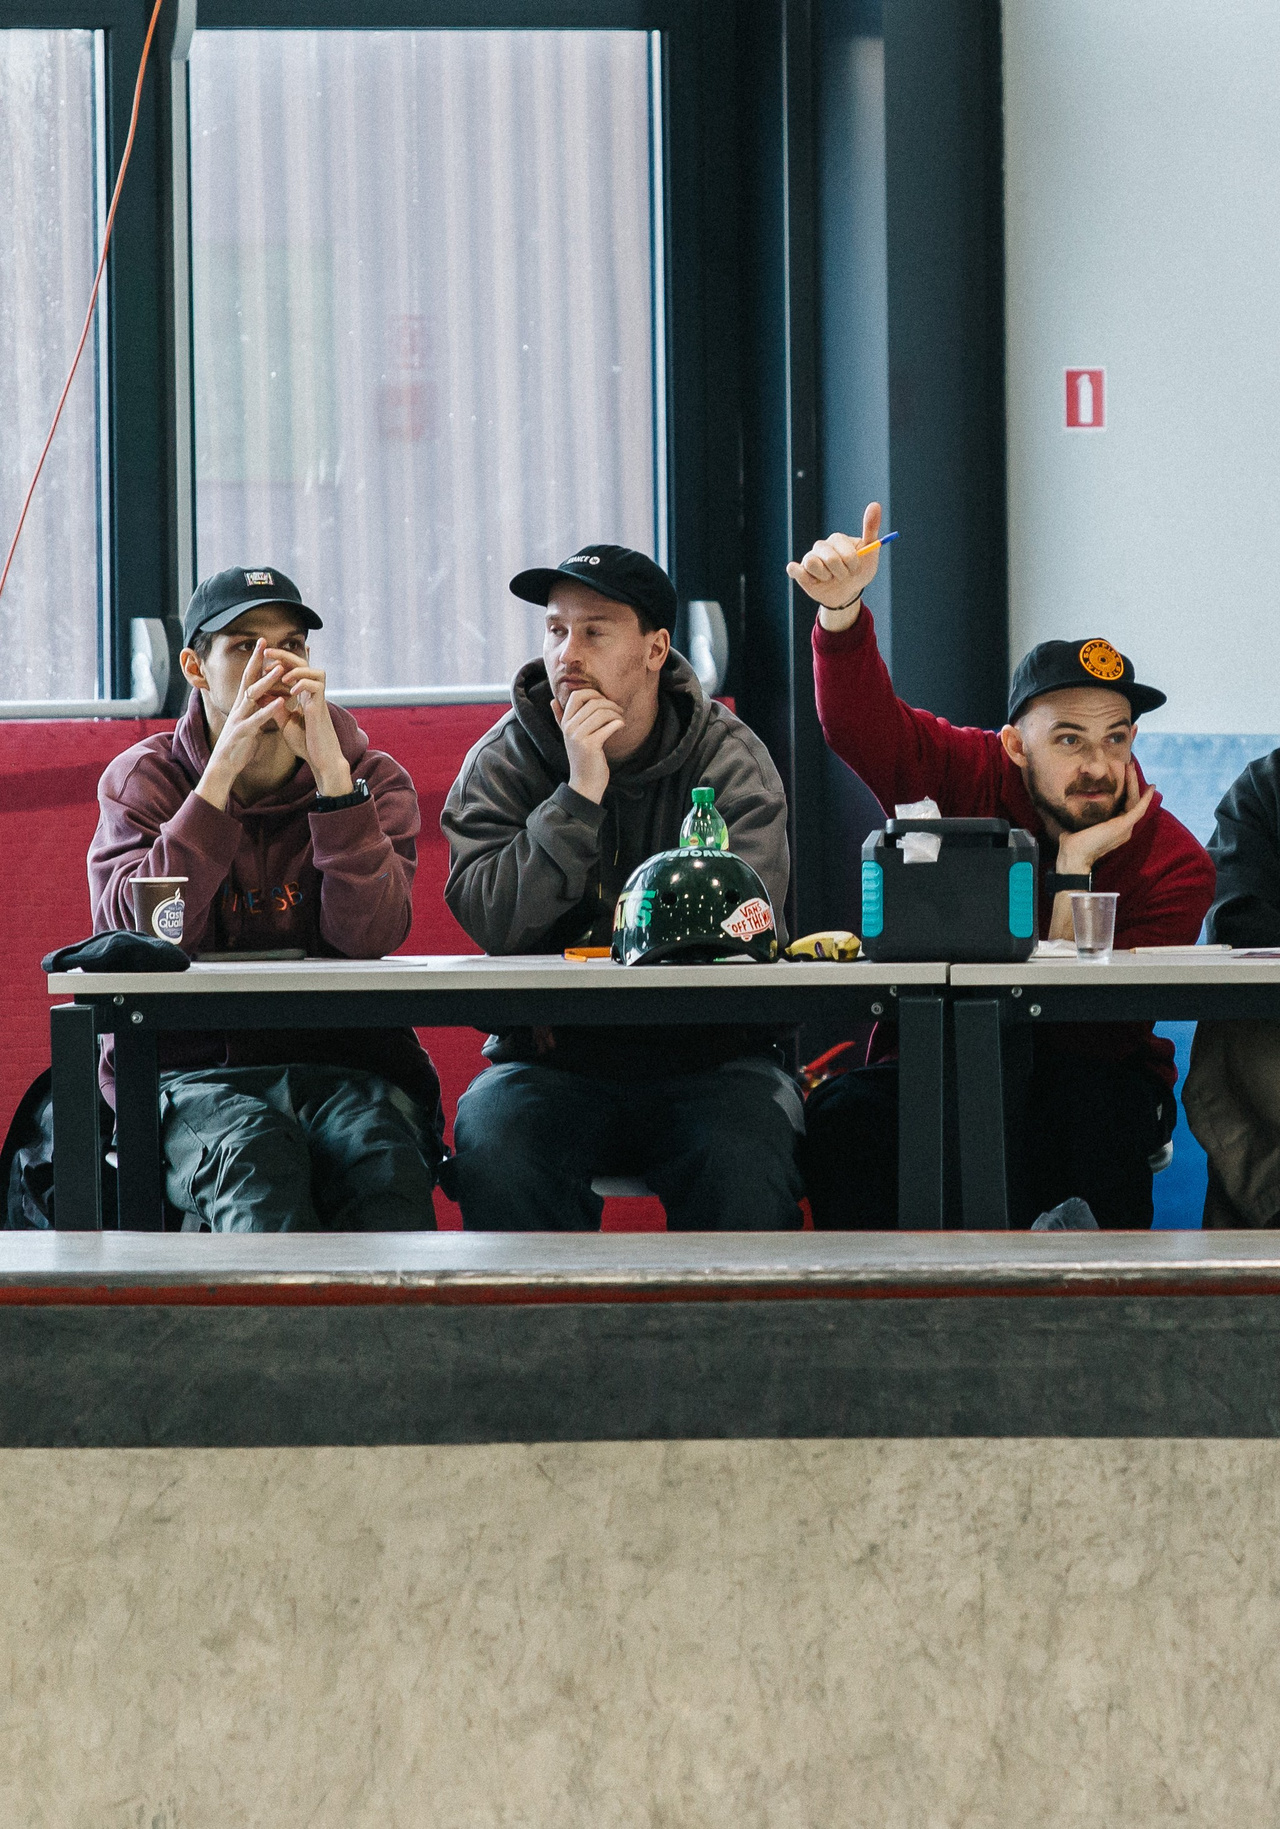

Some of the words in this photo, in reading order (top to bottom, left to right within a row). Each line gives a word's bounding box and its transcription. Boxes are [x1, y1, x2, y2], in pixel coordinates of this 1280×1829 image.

[271, 881, 303, 911] SB
[740, 901, 762, 918] VANS
[747, 911, 764, 930] THE
